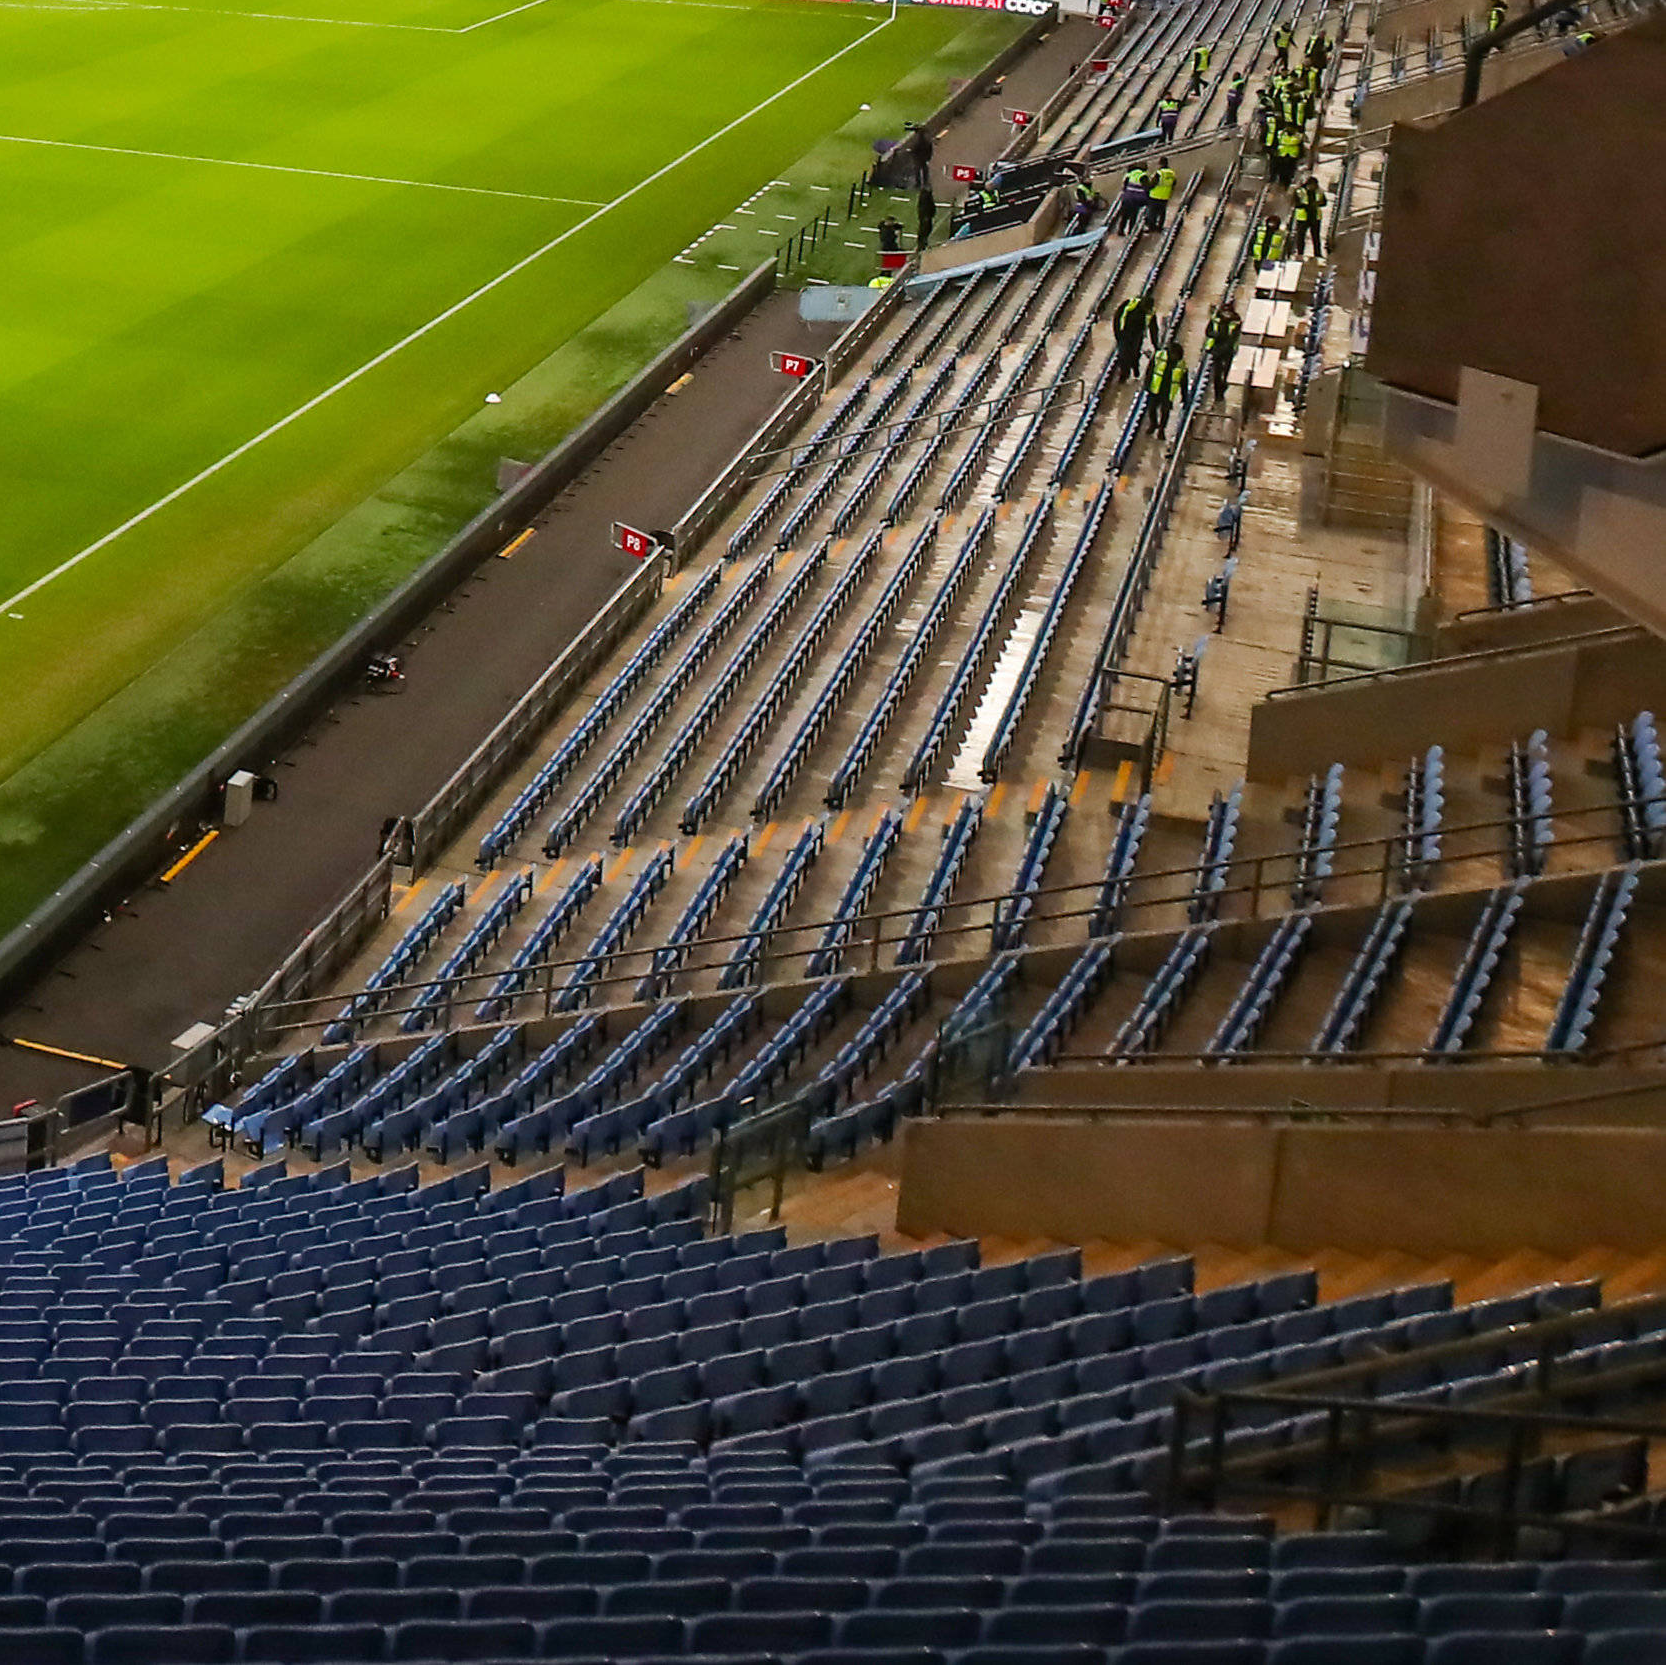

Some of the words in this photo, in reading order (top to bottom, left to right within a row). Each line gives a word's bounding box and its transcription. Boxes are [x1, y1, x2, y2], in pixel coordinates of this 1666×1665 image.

[955, 168, 970, 180] P5
[784, 359, 800, 373] P7
[625, 534, 642, 552] P8
